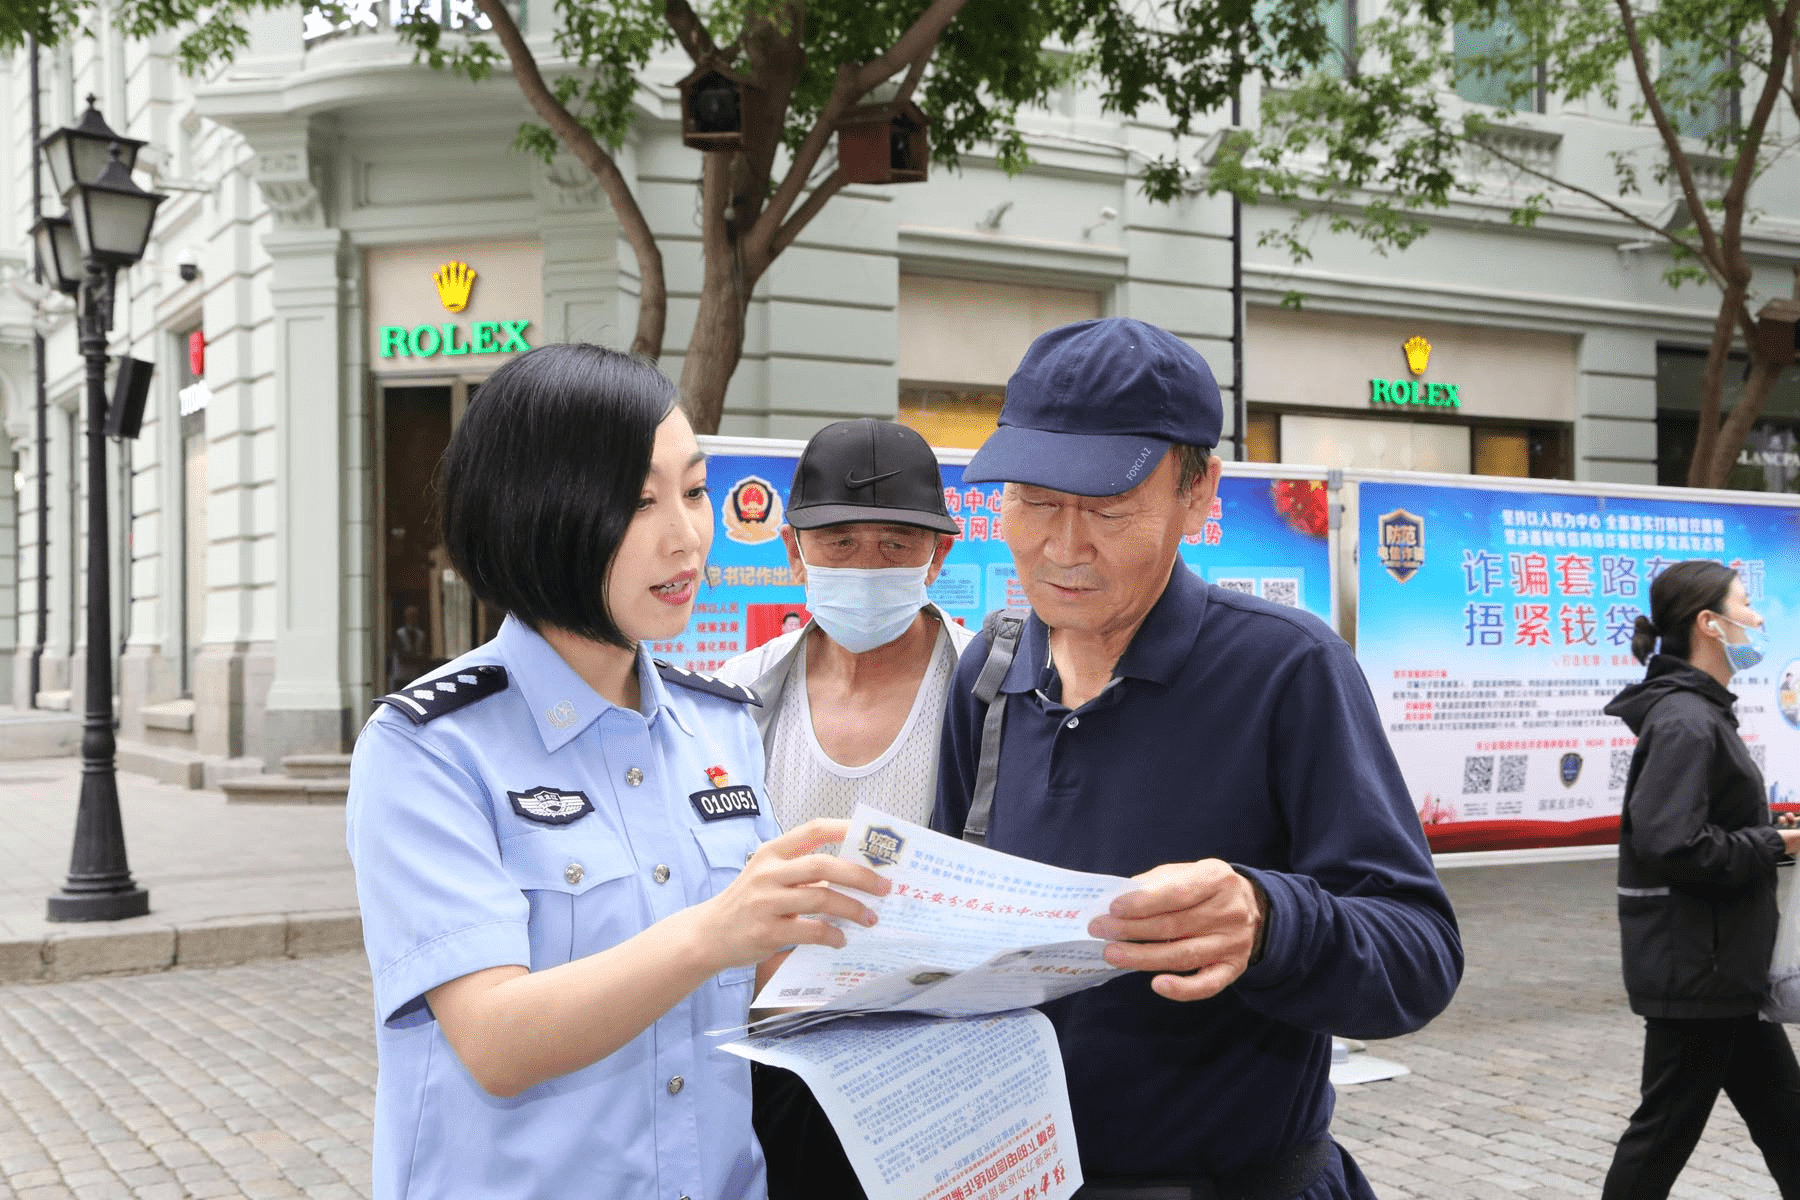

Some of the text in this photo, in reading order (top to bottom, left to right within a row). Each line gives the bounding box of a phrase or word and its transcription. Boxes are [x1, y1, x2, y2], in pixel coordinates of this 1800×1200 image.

[378, 320, 530, 359] ROLEX
[1371, 378, 1461, 407] ROLEX
[1125, 447, 1152, 482] FORCLAZ
[700, 790, 758, 815] 010051
